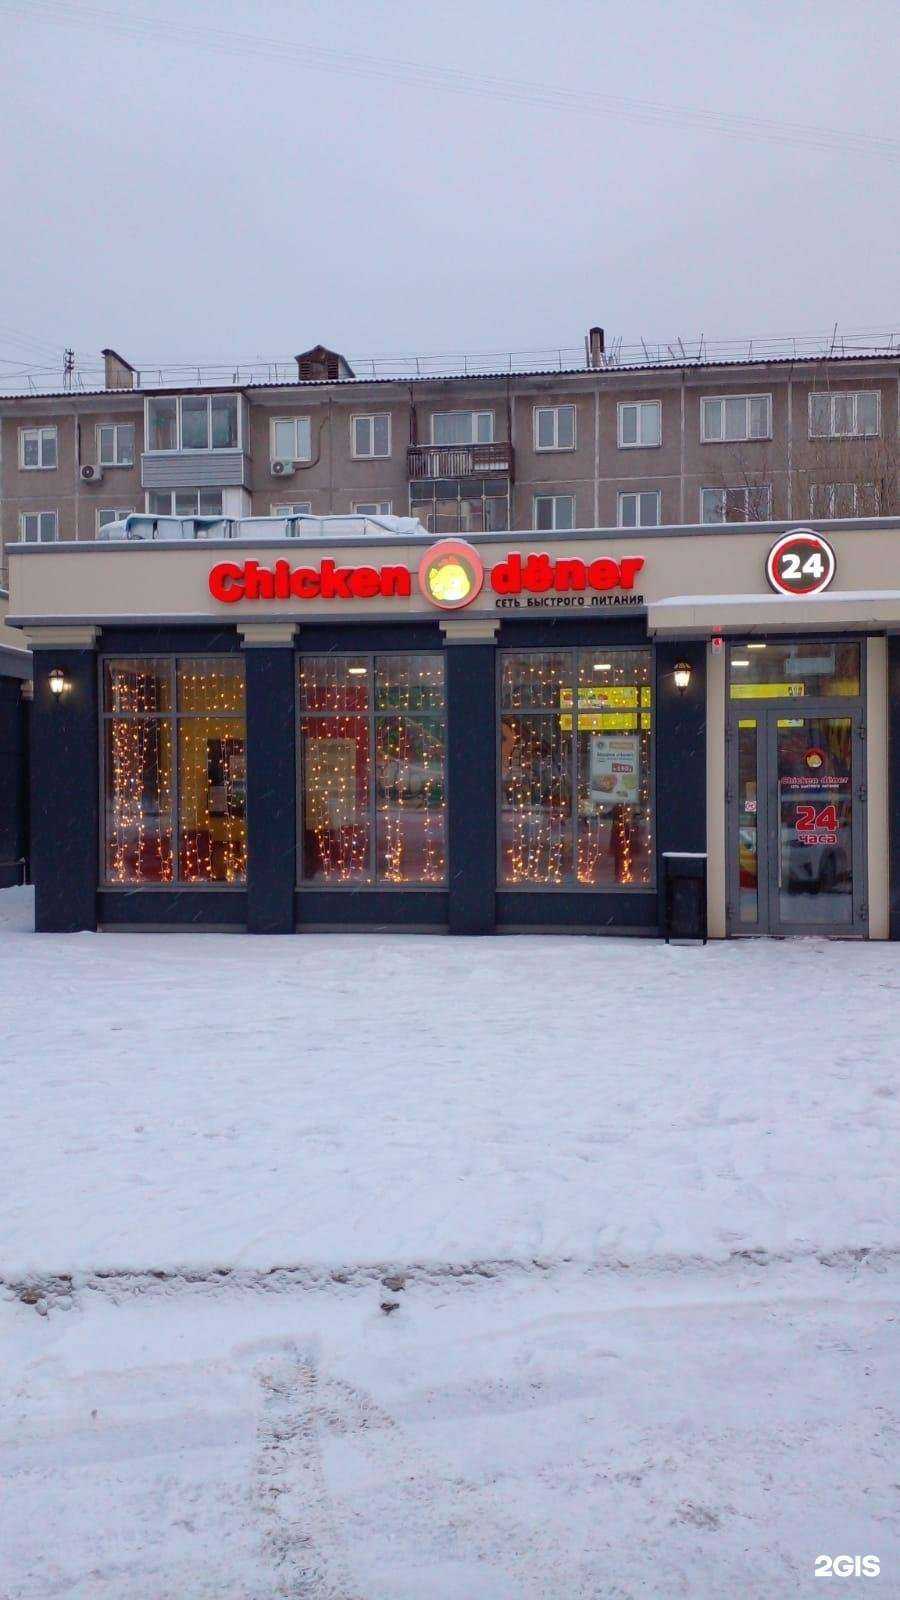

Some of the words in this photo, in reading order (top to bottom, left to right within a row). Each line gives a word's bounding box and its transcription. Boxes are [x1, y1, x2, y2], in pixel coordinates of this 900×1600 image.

[208, 557, 411, 603] Chicken
[491, 551, 644, 594] döner
[781, 553, 824, 579] 24
[495, 598, 521, 608] СЕТЬ
[527, 596, 585, 608] БЫСТРОГО
[591, 595, 644, 607] ПИТАНИЯ
[795, 805, 840, 832] 24
